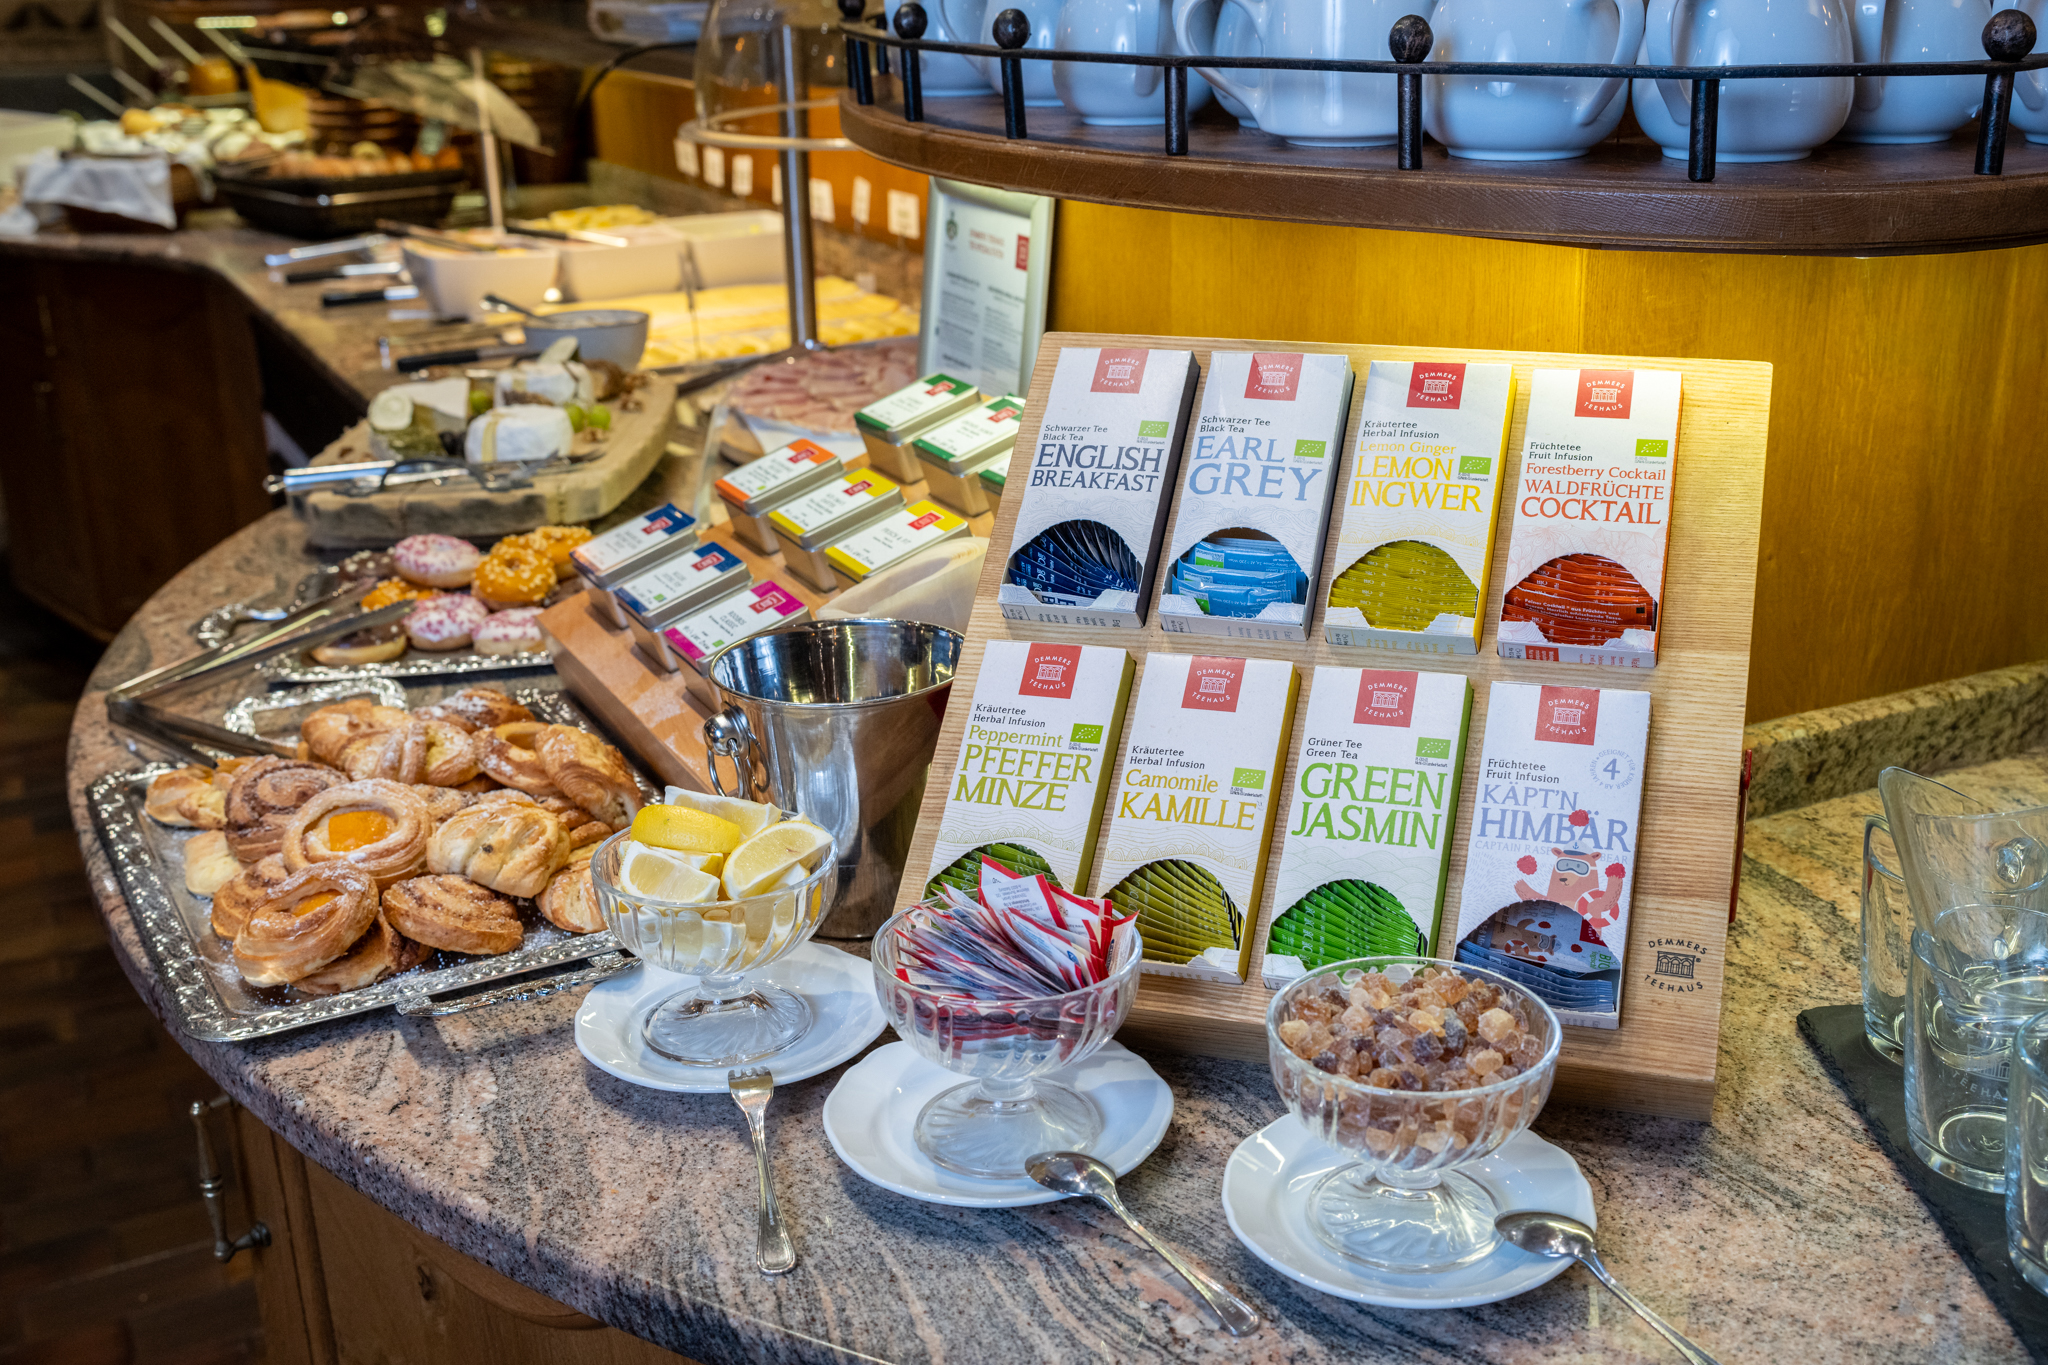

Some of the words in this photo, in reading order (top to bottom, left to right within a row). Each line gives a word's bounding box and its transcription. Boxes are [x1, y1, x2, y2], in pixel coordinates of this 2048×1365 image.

[1104, 358, 1140, 366] DEMMERS
[1100, 378, 1134, 387] TEEHAUS
[1419, 372, 1457, 381] DEMMERS
[1254, 385, 1290, 394] TEEHAUS
[1586, 380, 1625, 389] DEMMERS
[1416, 393, 1453, 402] TEEHAUS
[1584, 402, 1623, 411] TEEHAUS
[1202, 416, 1252, 425] Schwarzer
[1254, 418, 1271, 426] Tee
[1228, 425, 1245, 433] Tea
[1400, 430, 1440, 438] Infusion
[1194, 436, 1285, 463] EARL
[1360, 441, 1405, 452] Lemon
[1410, 442, 1456, 456] Ginger
[1530, 442, 1581, 451] Früchtetee
[1035, 444, 1164, 472] ENGLISH
[1554, 453, 1593, 461] Infusion
[1355, 456, 1455, 480] LEMON
[1526, 463, 1604, 479] Forestberry
[1609, 467, 1666, 480] Cocktail
[1030, 470, 1158, 492] BREAKFAST
[1189, 463, 1323, 501] GREY
[1350, 480, 1483, 512] INGWER
[1525, 479, 1664, 500] WALDFRÜCHTE
[1521, 496, 1661, 524] COCKTAIL
[1035, 656, 1071, 666] DEMMERS
[1196, 669, 1235, 679] DEMMERS
[1029, 679, 1066, 690] TEEHAUS
[1368, 683, 1408, 693] DEMMERS
[1192, 692, 1230, 703] TEEHAUS
[976, 704, 1026, 716] Kräutertee
[1548, 699, 1589, 710] DEMMERS
[1364, 707, 1404, 718] TEEHAUS
[973, 714, 1005, 724] Herbal
[1008, 717, 1046, 728] Infusion
[968, 725, 1063, 747] Peppermint
[1545, 724, 1586, 735] TEEHAUS
[1308, 738, 1342, 748] Grüner
[1345, 740, 1362, 749] Tee
[1132, 745, 1184, 756] Kräutertee
[1306, 749, 1336, 757] Green
[1341, 750, 1358, 760] Tea
[960, 744, 1092, 783] PFEFFER
[1130, 757, 1163, 766] Herbal
[1166, 758, 1205, 769] Infusion
[1488, 759, 1546, 771] Früchtetee
[1602, 758, 1620, 780] 4
[1126, 769, 1218, 793] Camomile
[1486, 770, 1511, 780] Fruit
[1515, 771, 1560, 784] Infusion
[1300, 762, 1448, 809] GREEN
[952, 774, 1069, 812] MINZE
[1482, 781, 1579, 811] KÄPT'N
[1117, 792, 1257, 831] KAMILLE
[1291, 802, 1442, 850] JASMIN
[1477, 807, 1631, 852] HIMBÄR
[1475, 841, 1521, 853] CAPTAIN
[1600, 853, 1628, 864] BEAR
[1648, 938, 1708, 954] DEMMERS
[1598, 953, 1612, 970] BIO
[1644, 974, 1703, 992] TEEHAUS
